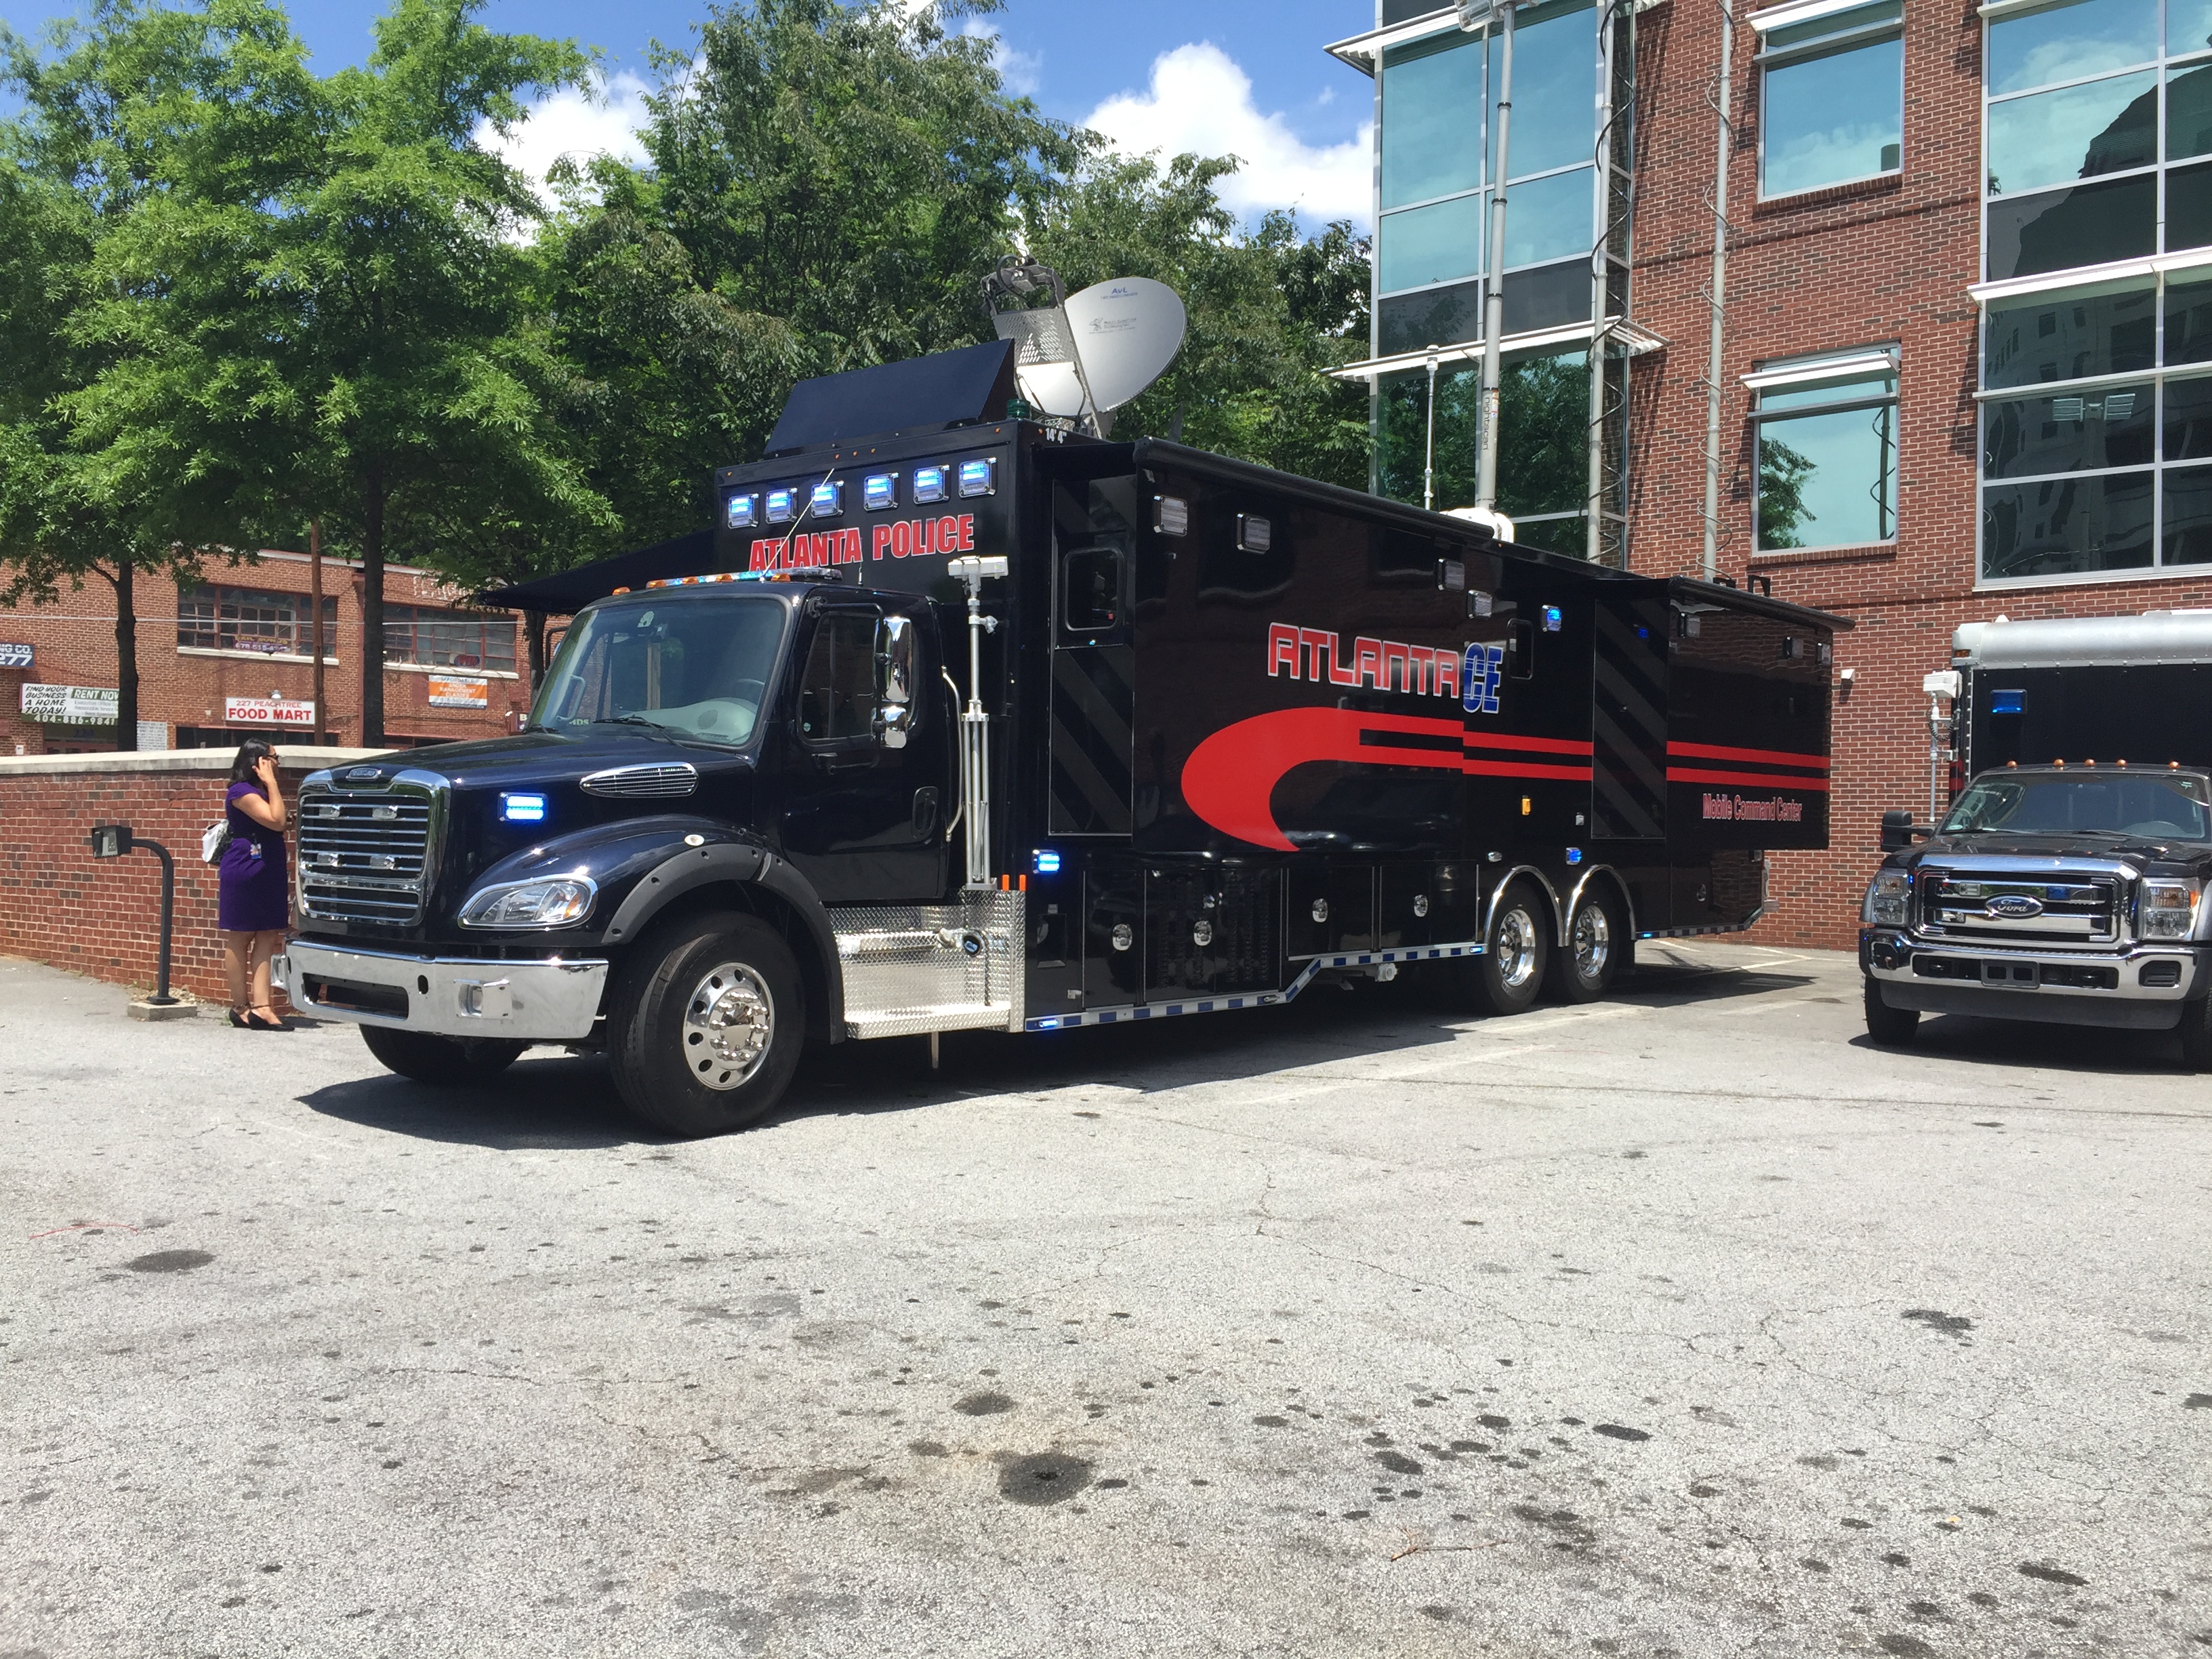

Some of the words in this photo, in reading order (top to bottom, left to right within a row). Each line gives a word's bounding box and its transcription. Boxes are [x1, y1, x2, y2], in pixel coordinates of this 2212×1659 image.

[1483, 396, 1491, 451] nightscan
[749, 527, 863, 573] ATLANTA
[873, 514, 974, 561] POLICE
[15, 644, 33, 654] CO.
[74, 689, 100, 699] RENT
[25, 706, 66, 714] TODAY!
[228, 708, 267, 719] FOOD
[272, 709, 312, 720] MART
[1702, 793, 1732, 820] Mobile
[1734, 794, 1776, 821] Command
[1776, 796, 1803, 821] Center
[1998, 899, 2028, 912] Ford
